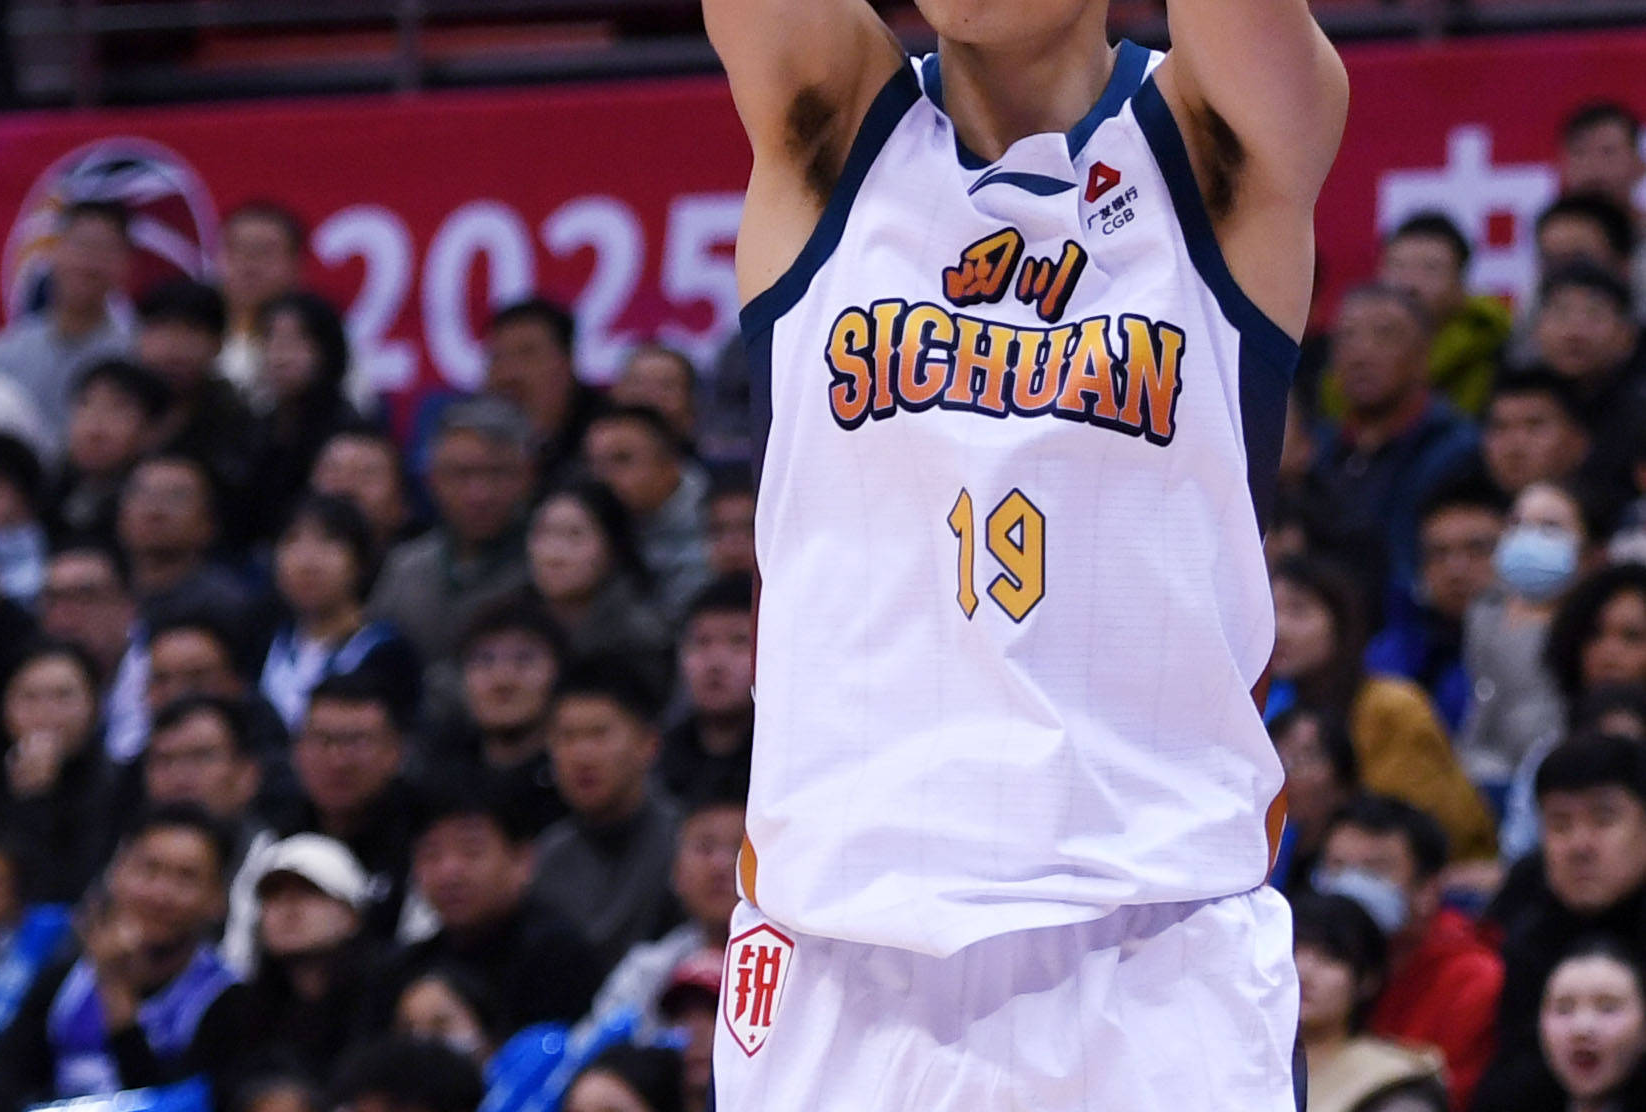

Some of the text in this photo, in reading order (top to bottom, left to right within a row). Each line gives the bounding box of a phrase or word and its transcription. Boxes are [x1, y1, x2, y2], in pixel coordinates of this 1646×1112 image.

[1087, 186, 1139, 230] 广发银行
[1102, 208, 1135, 235] CGB
[311, 193, 750, 393] 2025
[942, 227, 1086, 323] 四川
[825, 298, 1185, 447] SICHUAN
[947, 487, 1046, 624] 19
